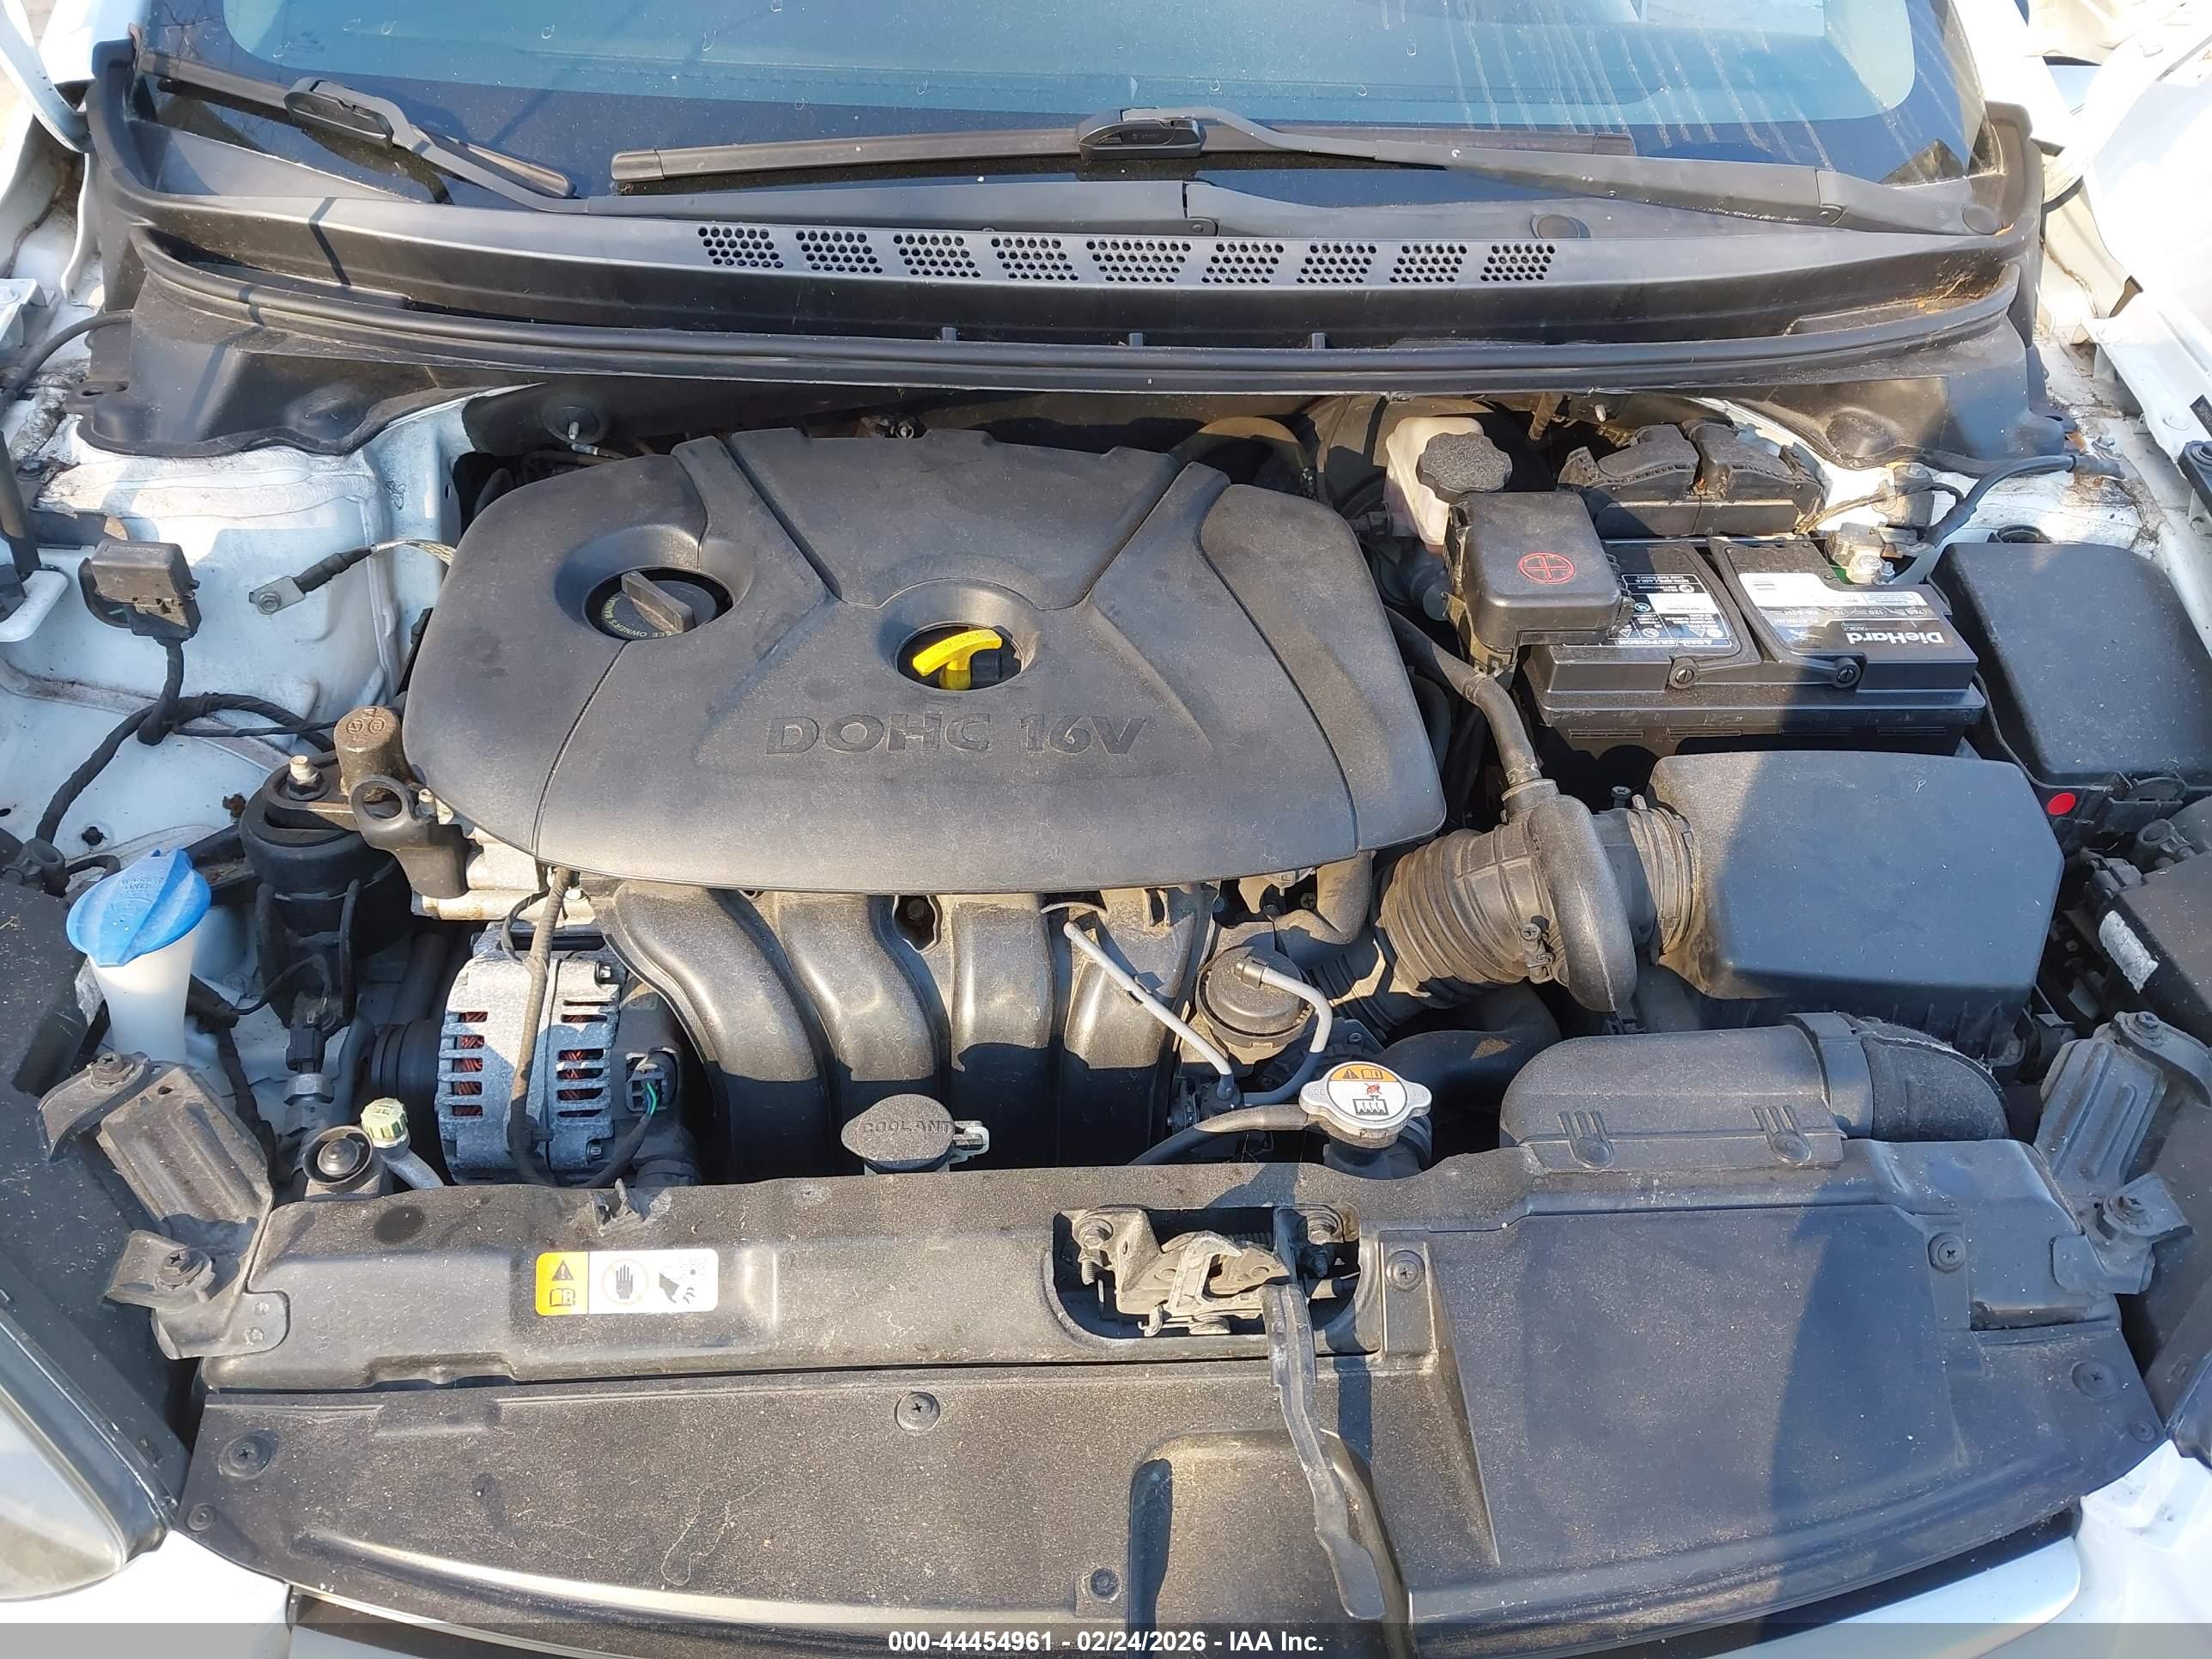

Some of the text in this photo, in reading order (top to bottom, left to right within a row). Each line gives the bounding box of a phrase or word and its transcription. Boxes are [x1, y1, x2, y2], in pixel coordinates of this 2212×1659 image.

[604, 597, 620, 619] MANUAL
[608, 620, 647, 637] OWNER'S
[1845, 631, 1945, 645] DieHard
[766, 714, 1146, 756] DOHC 16V
[863, 1119, 951, 1134] COOLANT
